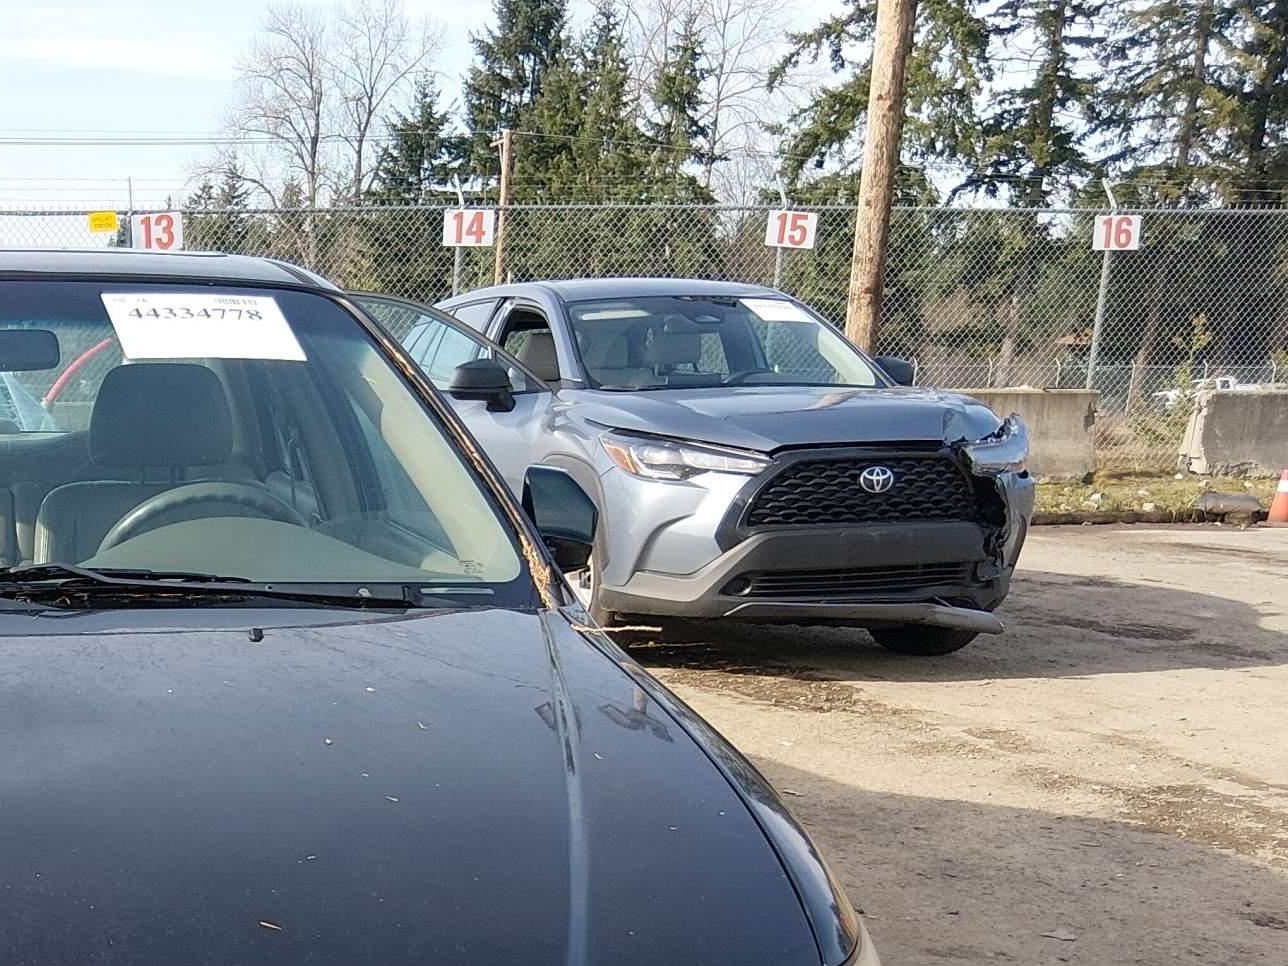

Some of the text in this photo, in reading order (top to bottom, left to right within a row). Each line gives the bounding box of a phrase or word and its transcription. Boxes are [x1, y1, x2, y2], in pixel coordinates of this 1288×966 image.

[141, 213, 175, 249] 13
[455, 211, 485, 244] 14
[778, 213, 808, 246] 15
[1104, 217, 1132, 248] 16
[128, 307, 263, 321] 44334778
